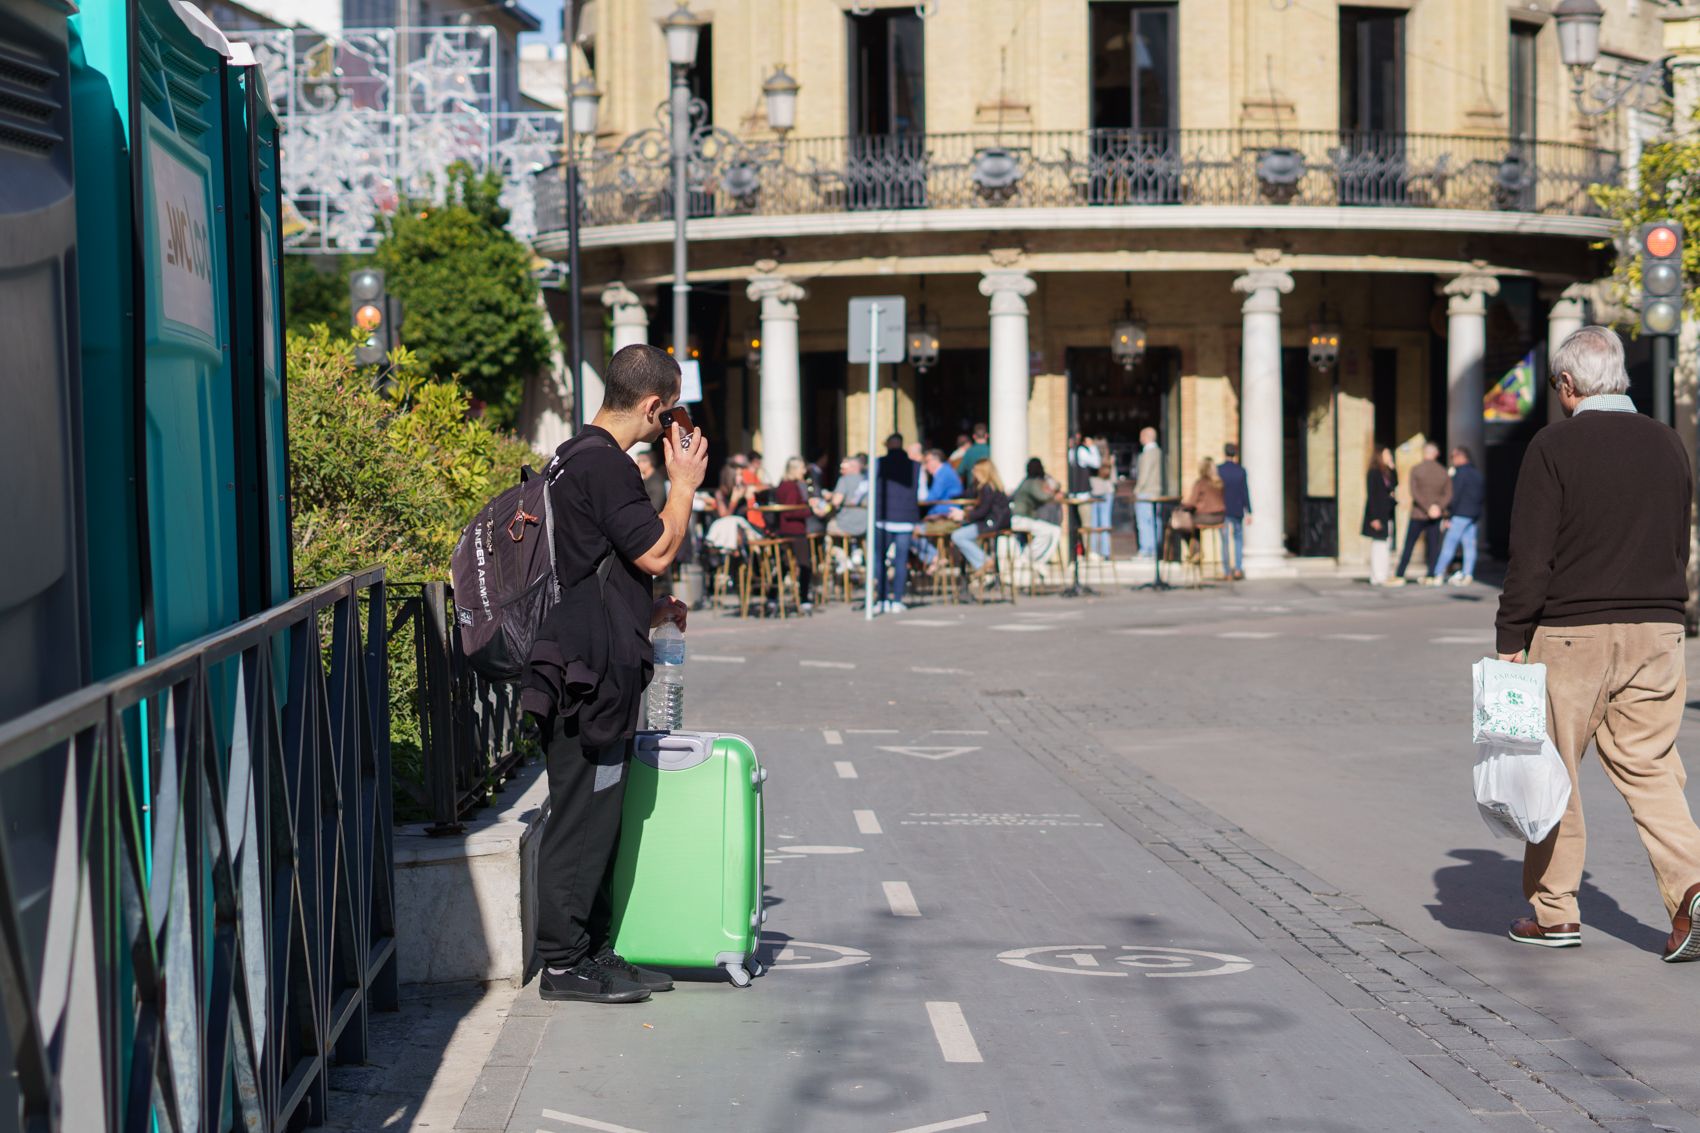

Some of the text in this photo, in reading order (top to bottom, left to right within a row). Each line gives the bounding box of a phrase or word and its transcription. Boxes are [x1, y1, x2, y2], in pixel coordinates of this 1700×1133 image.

[474, 522, 493, 622] UNDER ARMOUR
[1055, 953, 1194, 968] 10
